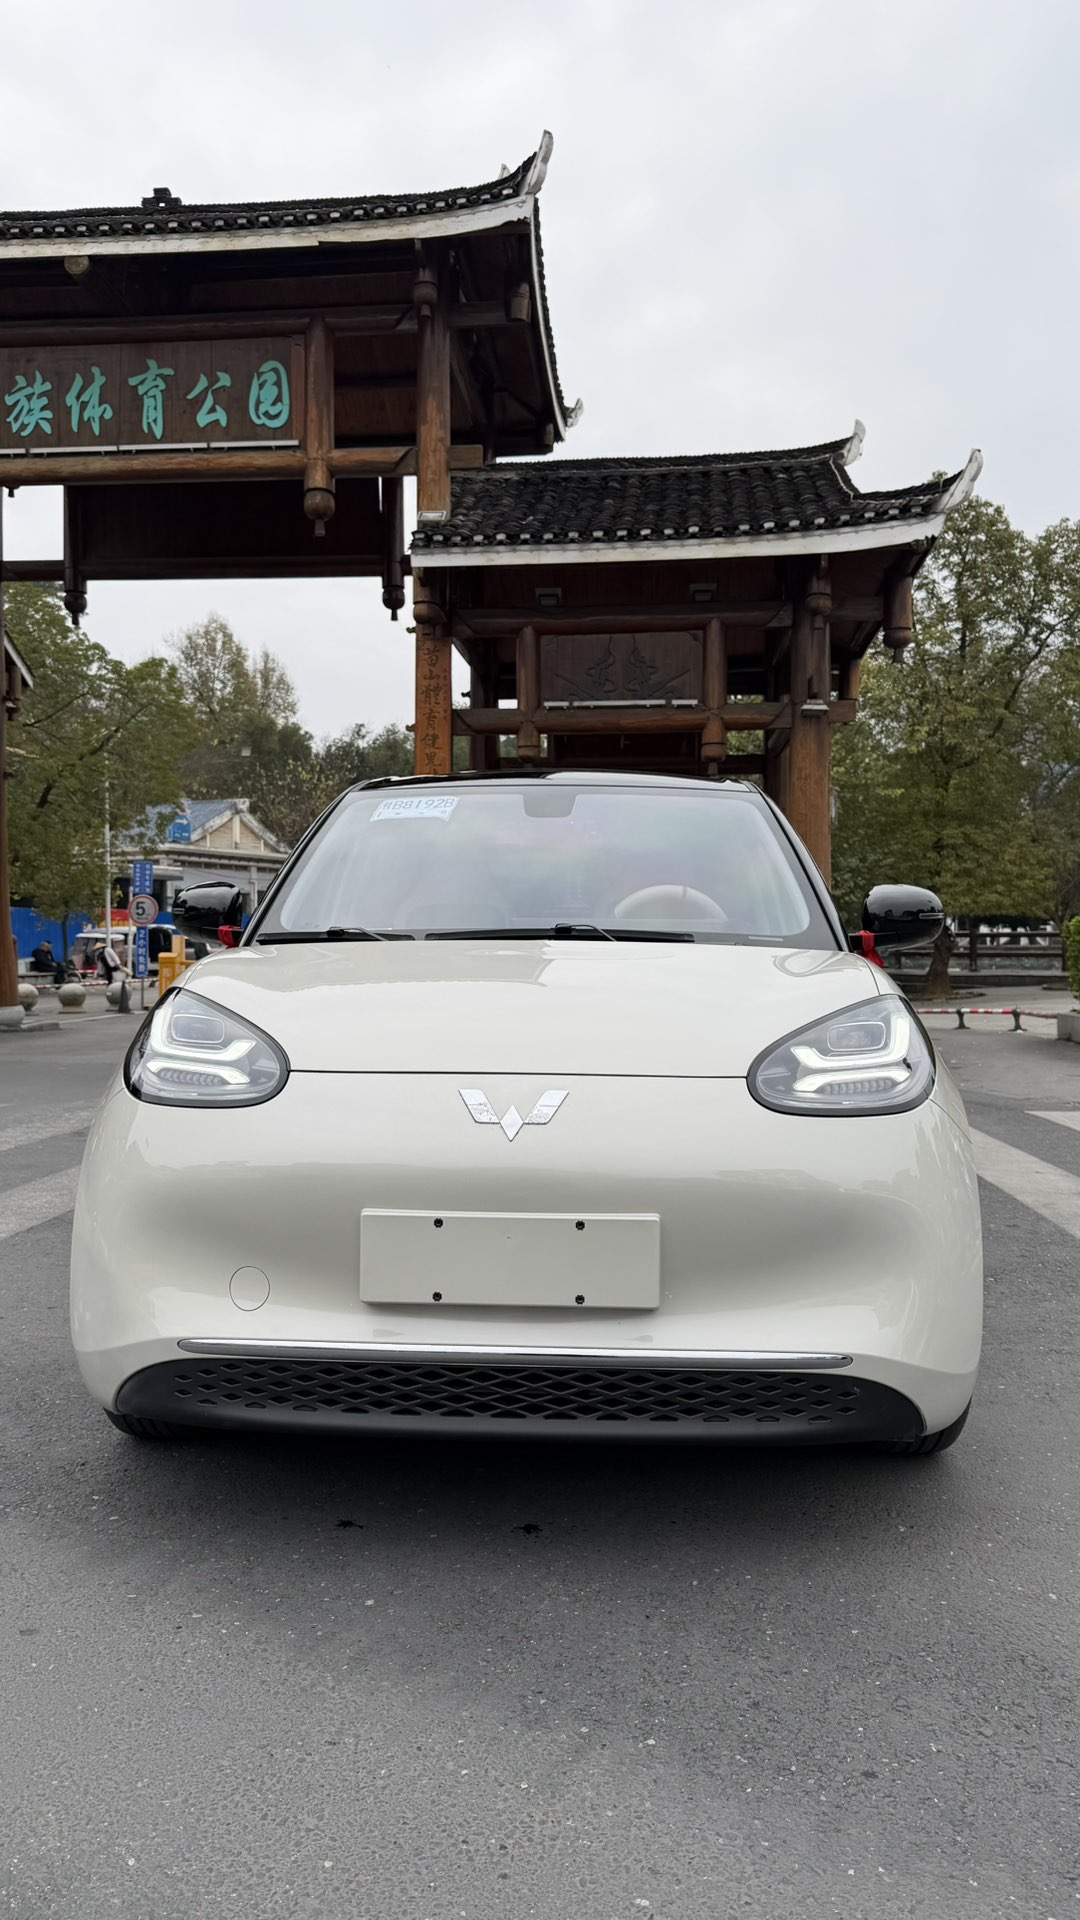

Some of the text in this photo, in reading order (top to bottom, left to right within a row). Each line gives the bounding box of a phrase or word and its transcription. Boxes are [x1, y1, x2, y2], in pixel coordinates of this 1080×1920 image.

[4, 358, 291, 440] 族体育公园
[136, 901, 146, 916] 5
